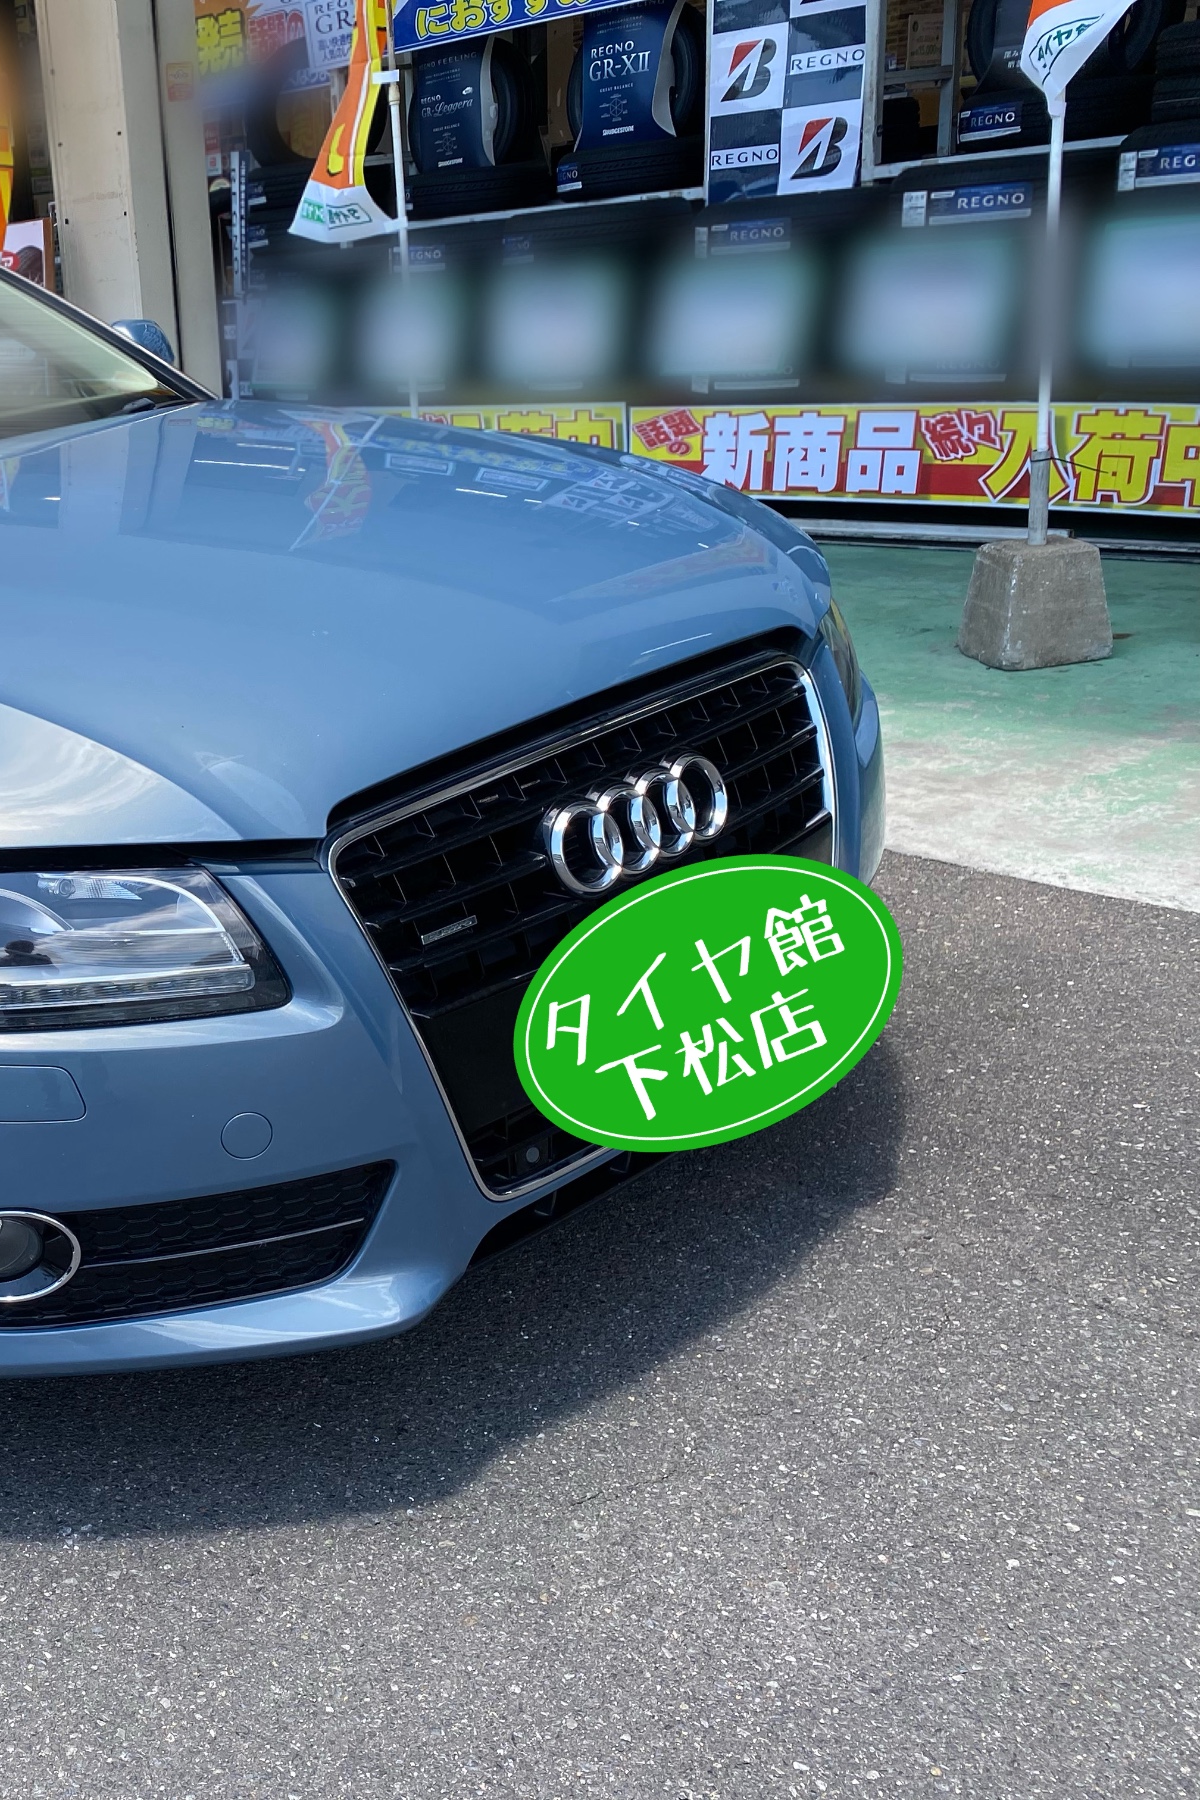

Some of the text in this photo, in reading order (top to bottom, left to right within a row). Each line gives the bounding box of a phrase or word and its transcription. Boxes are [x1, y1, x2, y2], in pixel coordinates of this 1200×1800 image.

[314, 0, 355, 15] REG
[315, 9, 357, 35] GR
[415, 0, 594, 39] におす
[437, 51, 478, 66] FEELING
[590, 40, 635, 59] REGNO
[791, 48, 865, 72] REGNO
[970, 111, 1015, 128] REGNO
[711, 148, 778, 167] REGNO
[956, 192, 1026, 210] REGNO
[730, 226, 785, 242] REGNO
[633, 408, 703, 456] 話題の
[701, 410, 922, 495] 新商品
[921, 408, 1001, 461] 続々
